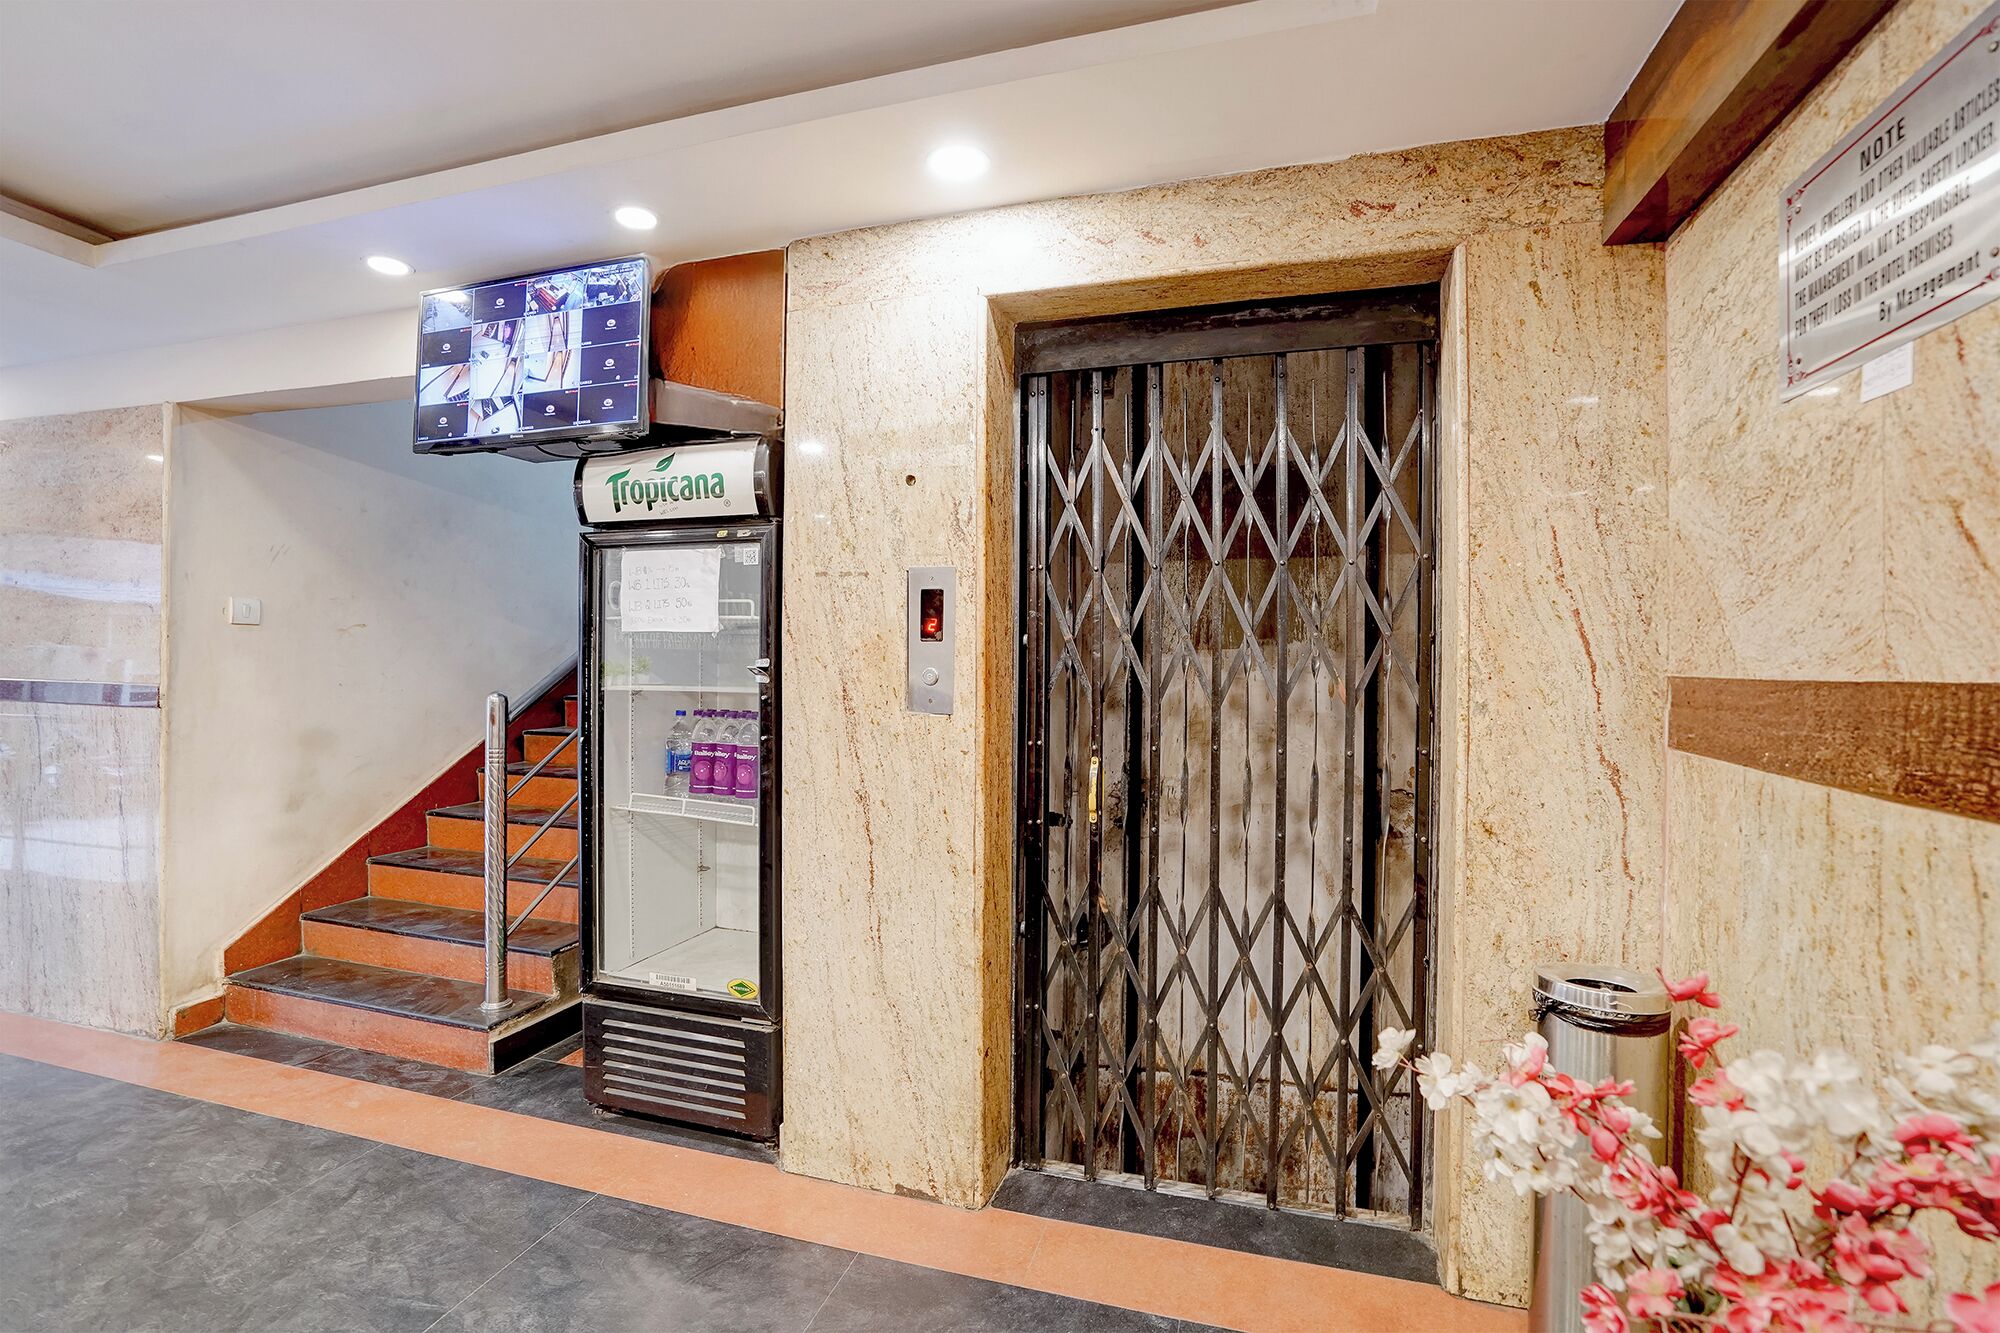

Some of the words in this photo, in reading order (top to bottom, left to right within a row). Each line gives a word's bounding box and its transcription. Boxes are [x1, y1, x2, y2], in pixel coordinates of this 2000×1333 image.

[1820, 191, 1857, 237] JEWELLERY
[1860, 177, 1875, 203] AND
[1878, 155, 1903, 194] OTHER
[1906, 117, 1949, 171] VALUABLE
[1953, 77, 2000, 137] ARTICLES
[1860, 116, 1906, 172] NOTE
[1794, 255, 1812, 283] MUST
[1814, 248, 1823, 270] BE
[1825, 220, 1861, 263] DEPOSITED
[1875, 199, 1890, 222] THE
[1920, 153, 1952, 193] SAFETY
[1794, 286, 1807, 311] THE
[1808, 255, 1855, 302] MANAGEMENT
[1857, 247, 1875, 272] WILL
[1877, 229, 1893, 258] NOT
[1896, 220, 1906, 246] BE
[1909, 176, 1970, 237] RESPONSIBLE
[1794, 315, 1807, 340] FOR
[1809, 302, 1829, 331] THEFT
[1834, 288, 1852, 316] LOSS
[1853, 281, 1863, 304] IN
[1864, 270, 1878, 296] THE
[1881, 253, 1905, 287] HOTEL
[1908, 223, 1953, 272] PREMISES
[1879, 299, 1893, 323] By
[1896, 250, 1981, 312] Management
[605, 468, 725, 514] Tropicana
[927, 618, 938, 632] 2
